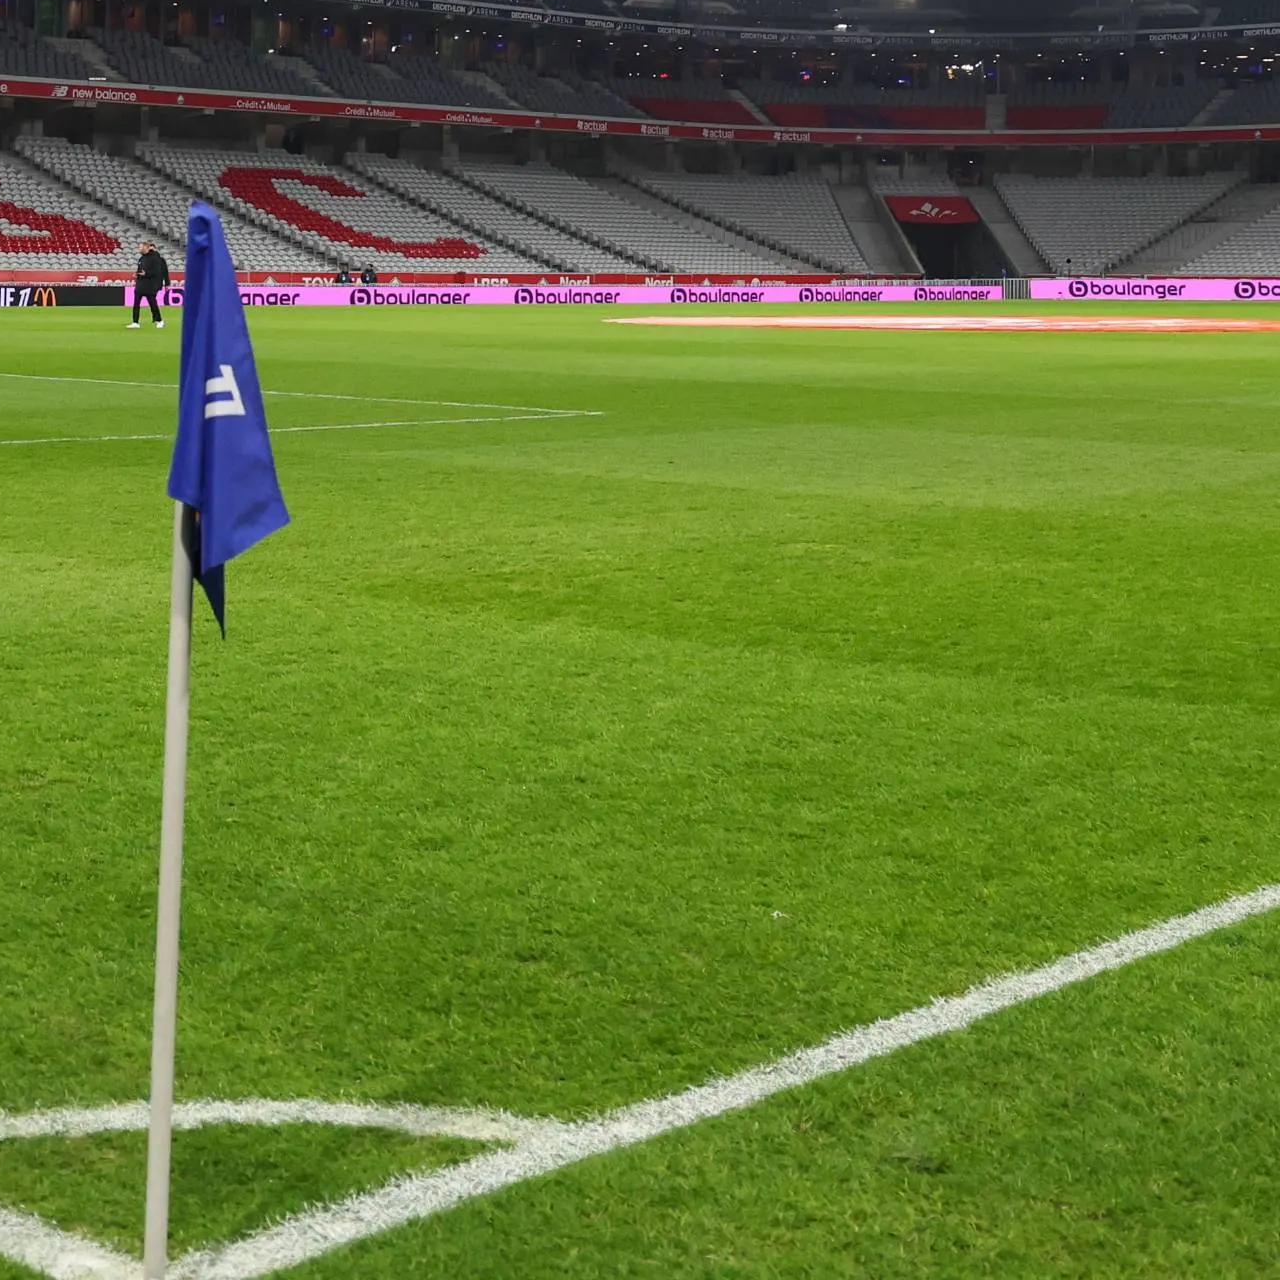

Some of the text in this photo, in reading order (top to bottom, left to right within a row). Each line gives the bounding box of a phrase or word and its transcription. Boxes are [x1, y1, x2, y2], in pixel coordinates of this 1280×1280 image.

[432, 2, 499, 17] DECATHLON ARENA
[511, 10, 543, 23] DECATHLON
[1149, 31, 1229, 42] DECATHLON ARENA
[72, 88, 137, 102] new balance
[236, 99, 291, 112] Crédit Mutuel
[345, 106, 396, 118] Crédit Mutuel
[583, 120, 608, 132] actual
[646, 124, 670, 136] actual
[708, 128, 735, 139] actual
[781, 132, 811, 142] actual
[373, 288, 471, 305] boulanger
[535, 288, 620, 304] boulanger
[685, 288, 765, 303] boulanger
[815, 288, 883, 302] boulanger
[928, 288, 991, 301] boulanger
[1090, 281, 1186, 299] boulanger
